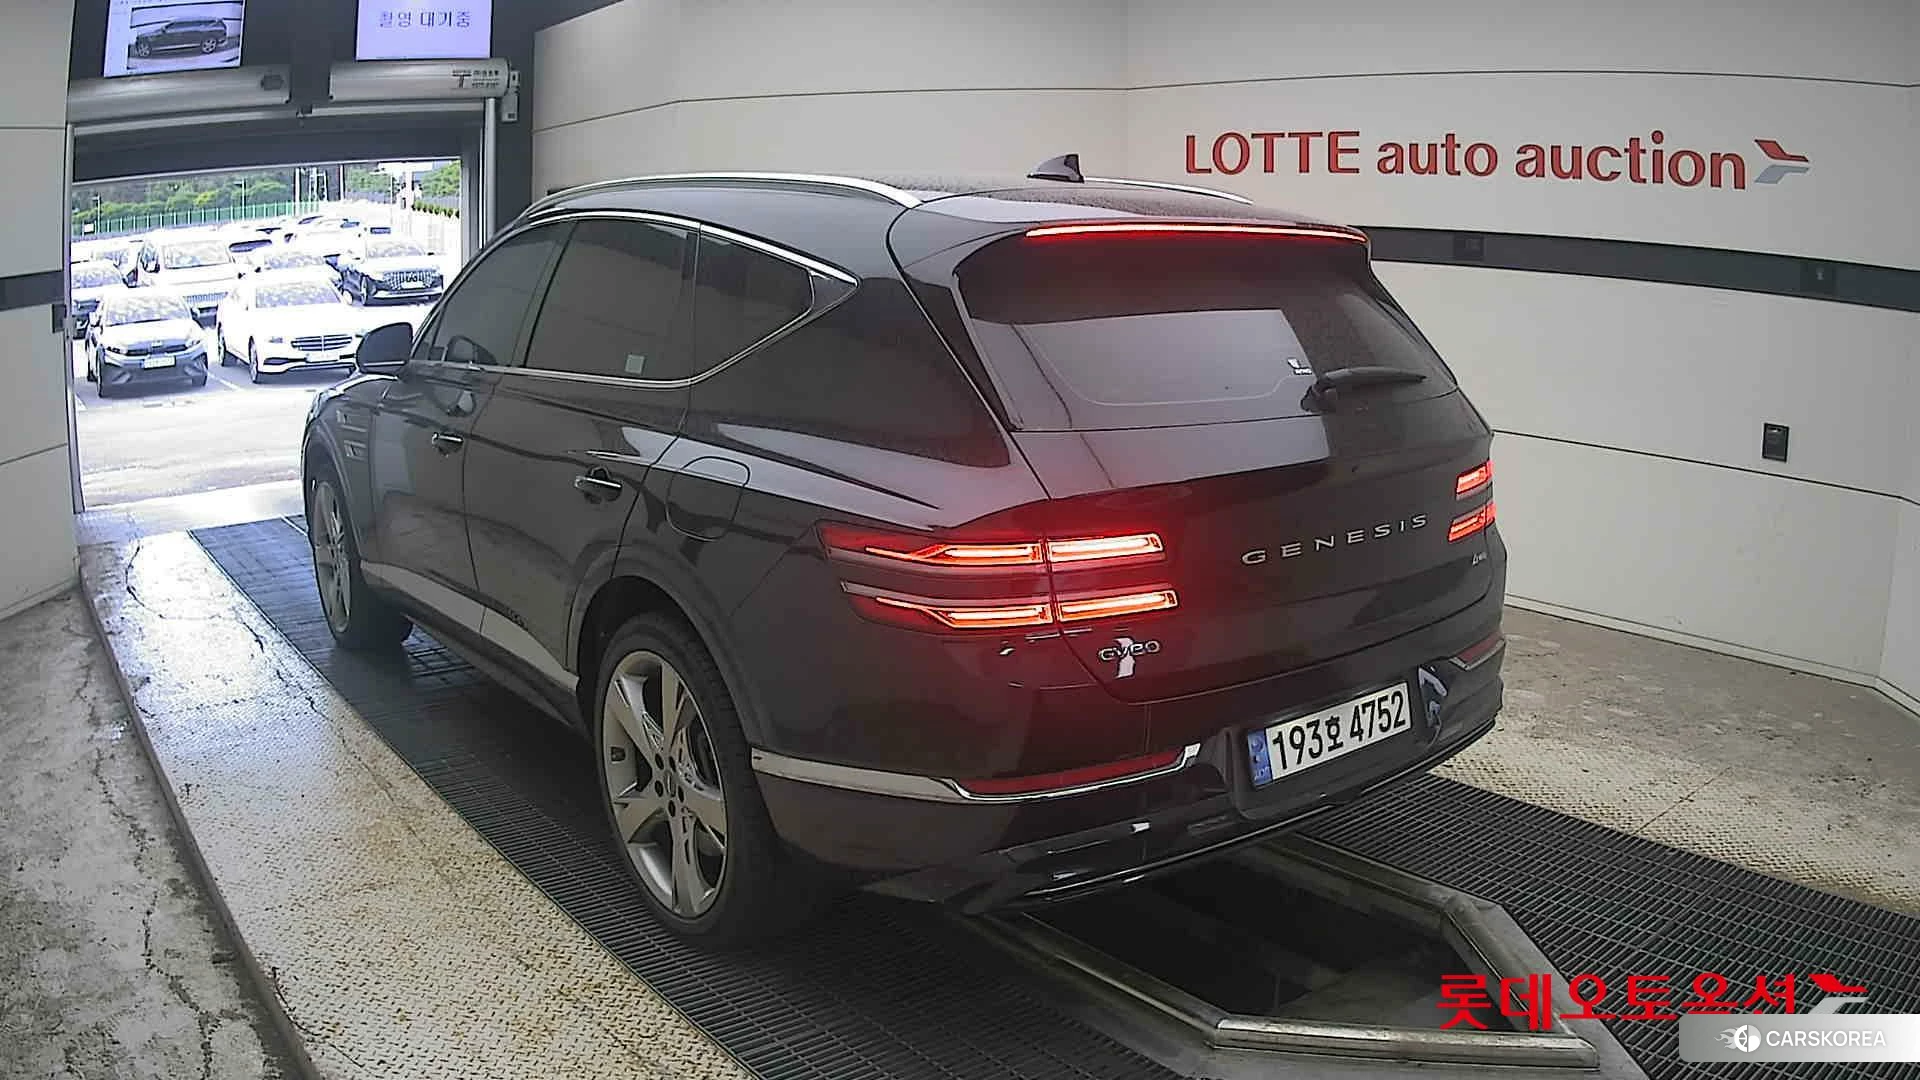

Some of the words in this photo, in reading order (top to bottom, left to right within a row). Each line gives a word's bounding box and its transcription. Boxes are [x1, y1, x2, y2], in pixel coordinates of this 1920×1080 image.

[420, 10, 471, 28] 대기중
[1185, 131, 1360, 175] LOTTE
[1377, 133, 1498, 177] auto
[1515, 130, 1746, 190] auction
[1241, 513, 1428, 566] GENESIS
[1272, 715, 1344, 770] 193호
[1349, 690, 1406, 742] 4752
